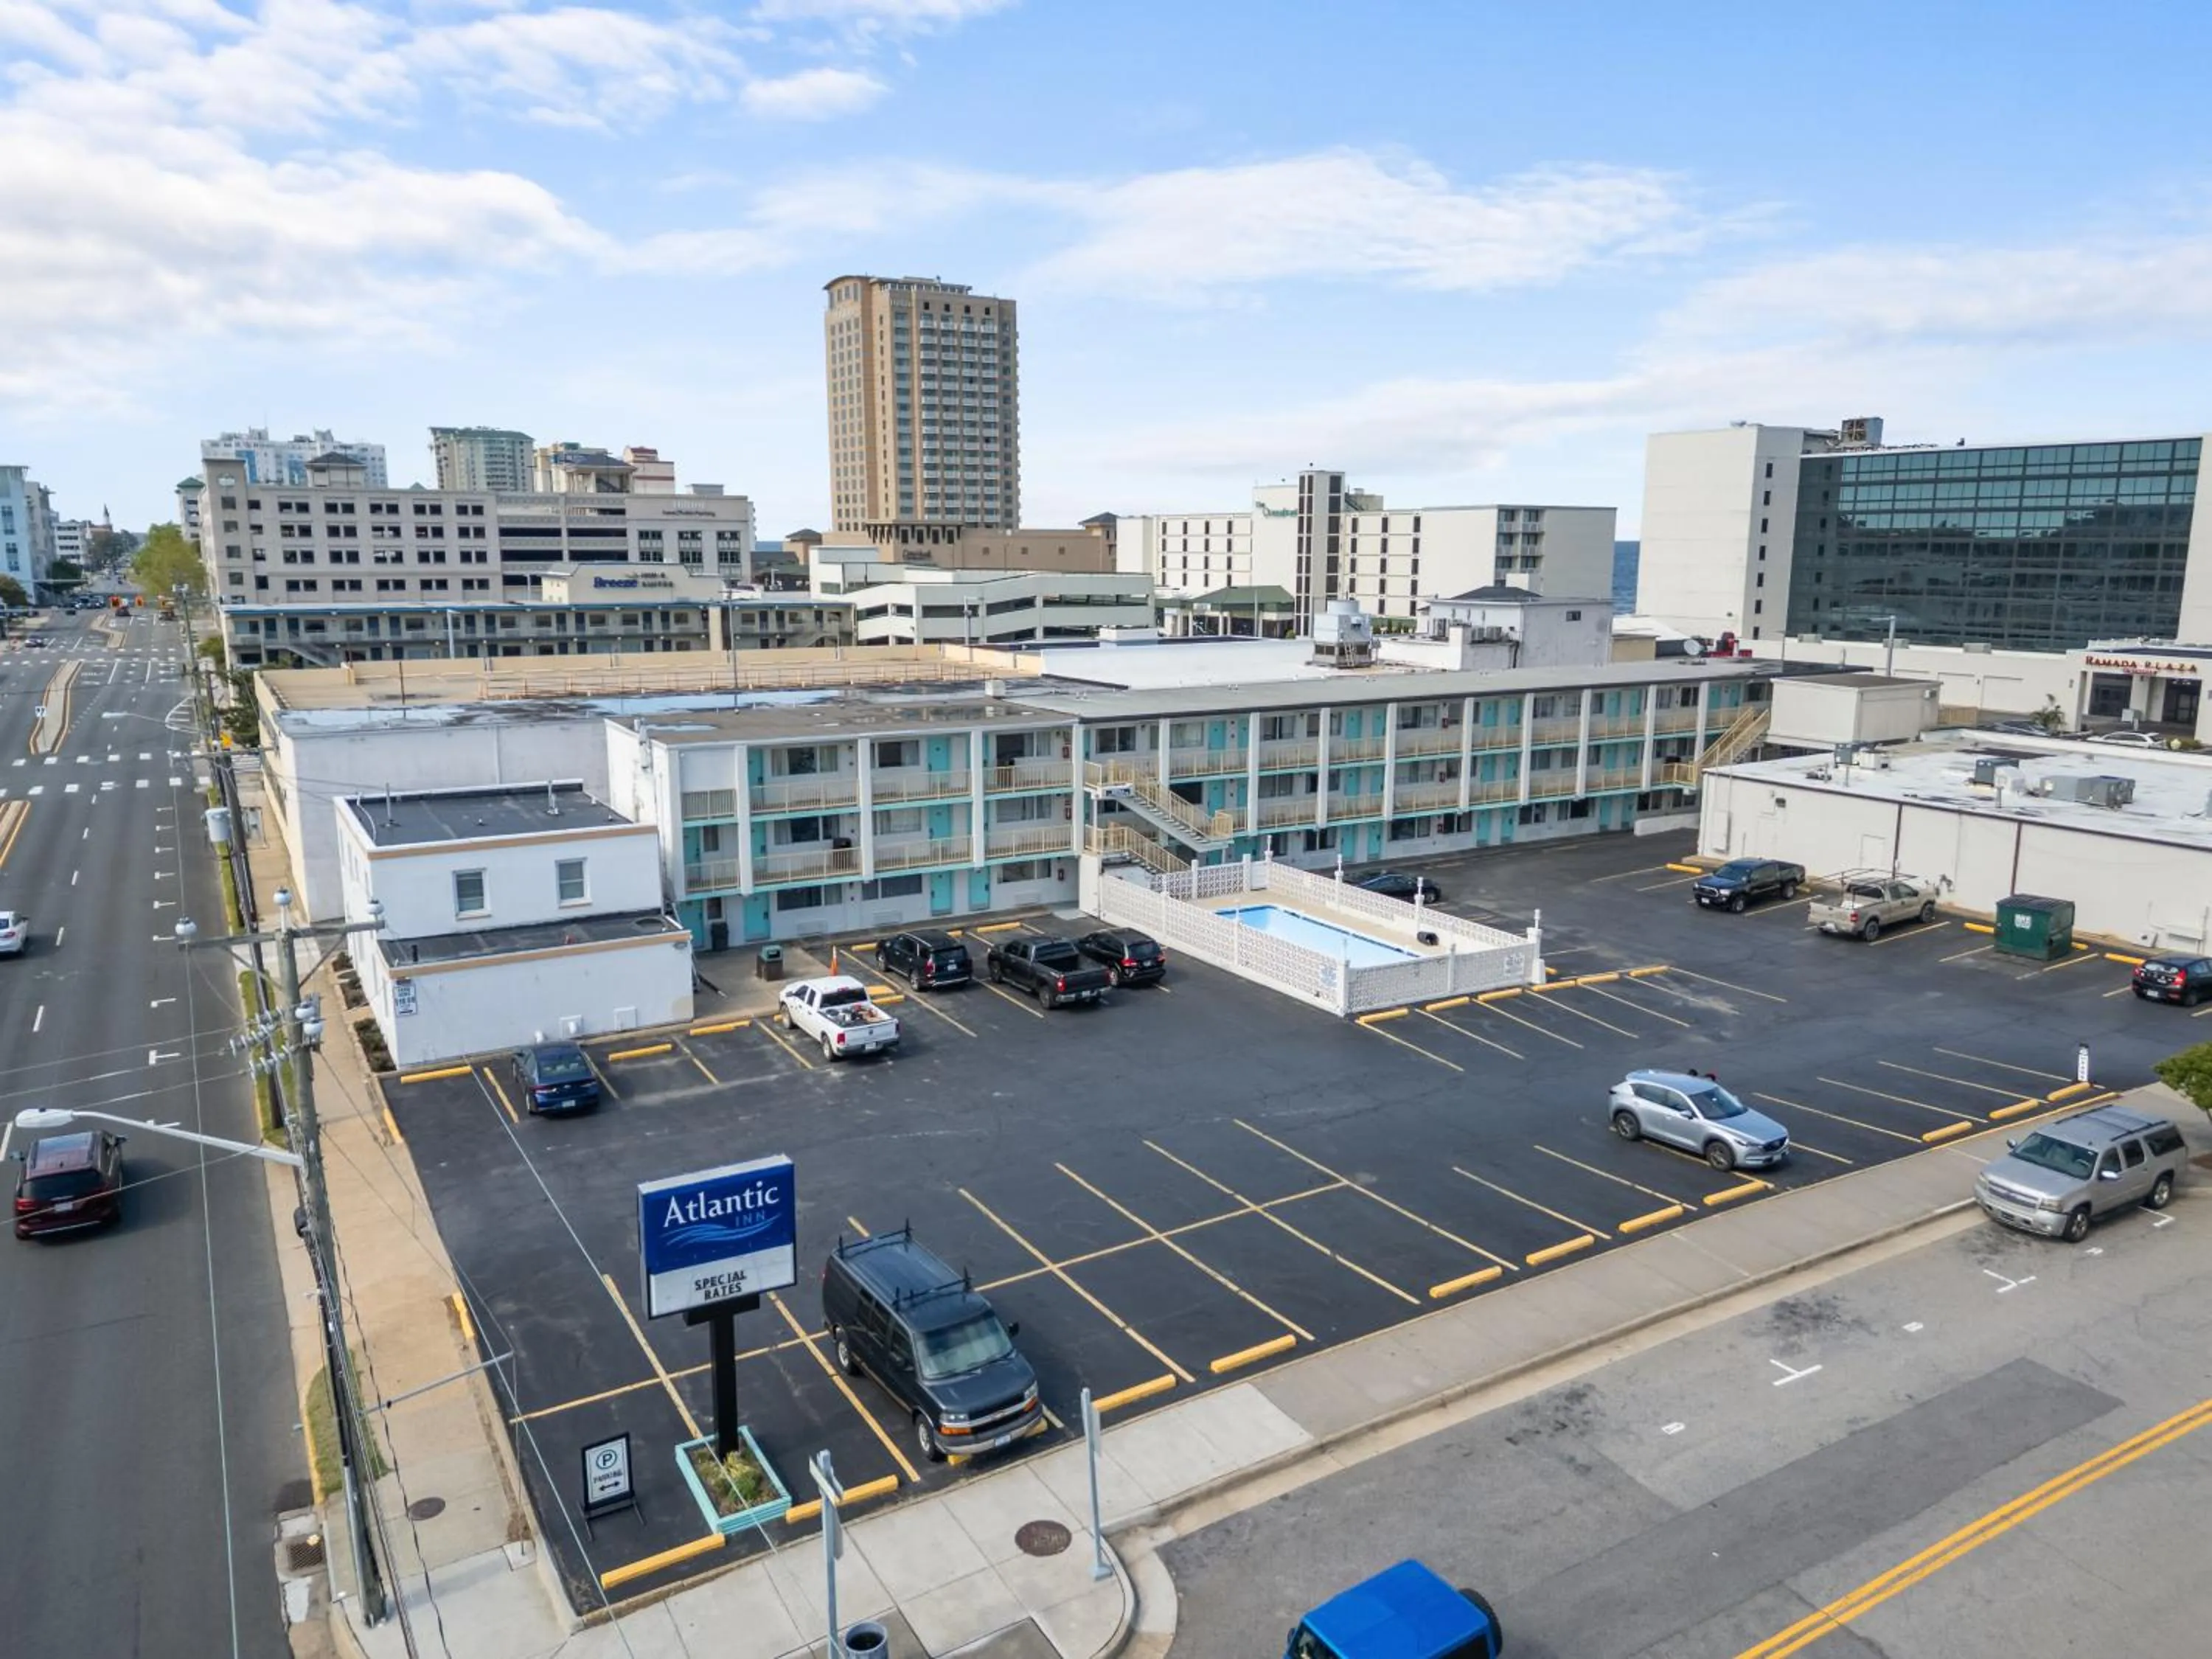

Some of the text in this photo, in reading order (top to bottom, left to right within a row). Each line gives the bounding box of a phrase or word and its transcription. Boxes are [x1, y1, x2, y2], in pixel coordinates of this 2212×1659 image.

[2085, 655, 2138, 668] RAMADA
[663, 1180, 779, 1228] Atlantic
[735, 1209, 765, 1227] INN
[695, 1270, 747, 1291] SPECIAL
[704, 1282, 742, 1301] RATES
